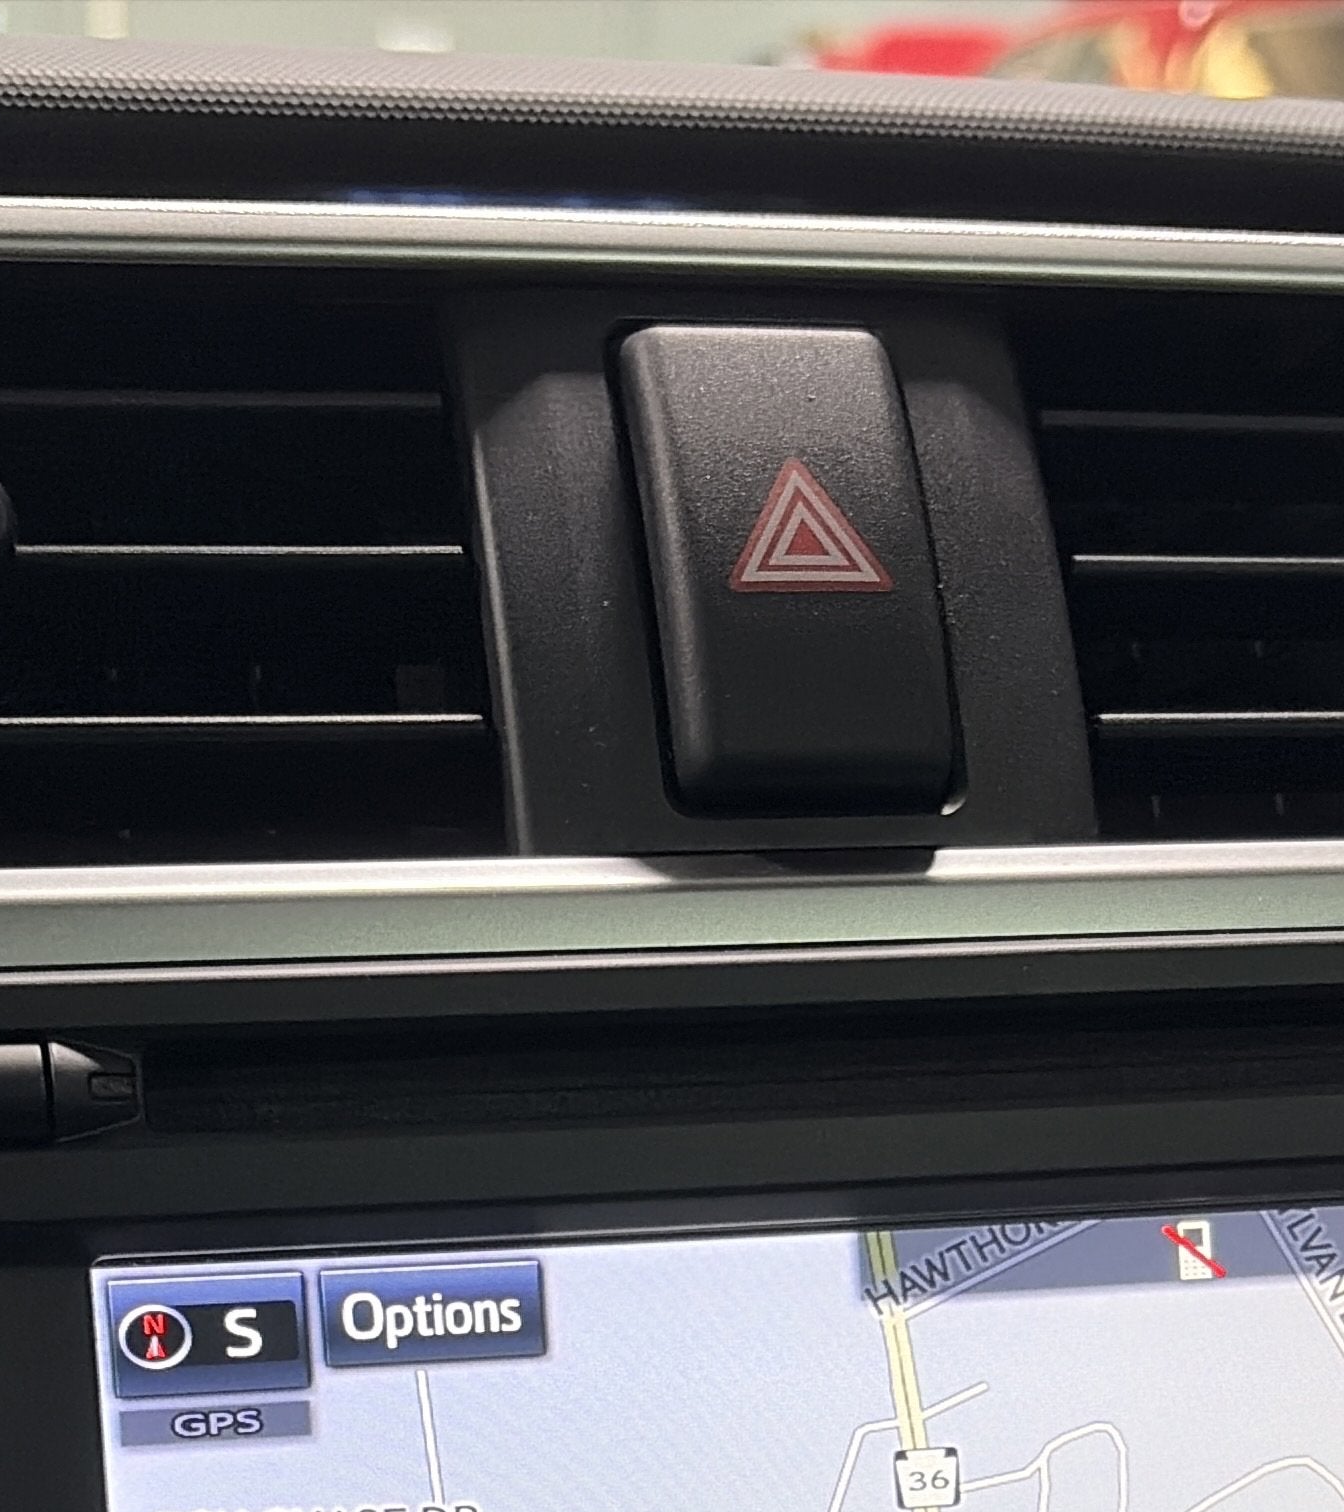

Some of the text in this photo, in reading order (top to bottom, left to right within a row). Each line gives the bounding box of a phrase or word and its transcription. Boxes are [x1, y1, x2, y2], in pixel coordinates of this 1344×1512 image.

[225, 1308, 263, 1357] S
[341, 1292, 522, 1348] Options
[172, 1410, 262, 1437] GPS
[908, 1469, 950, 1492] 36
